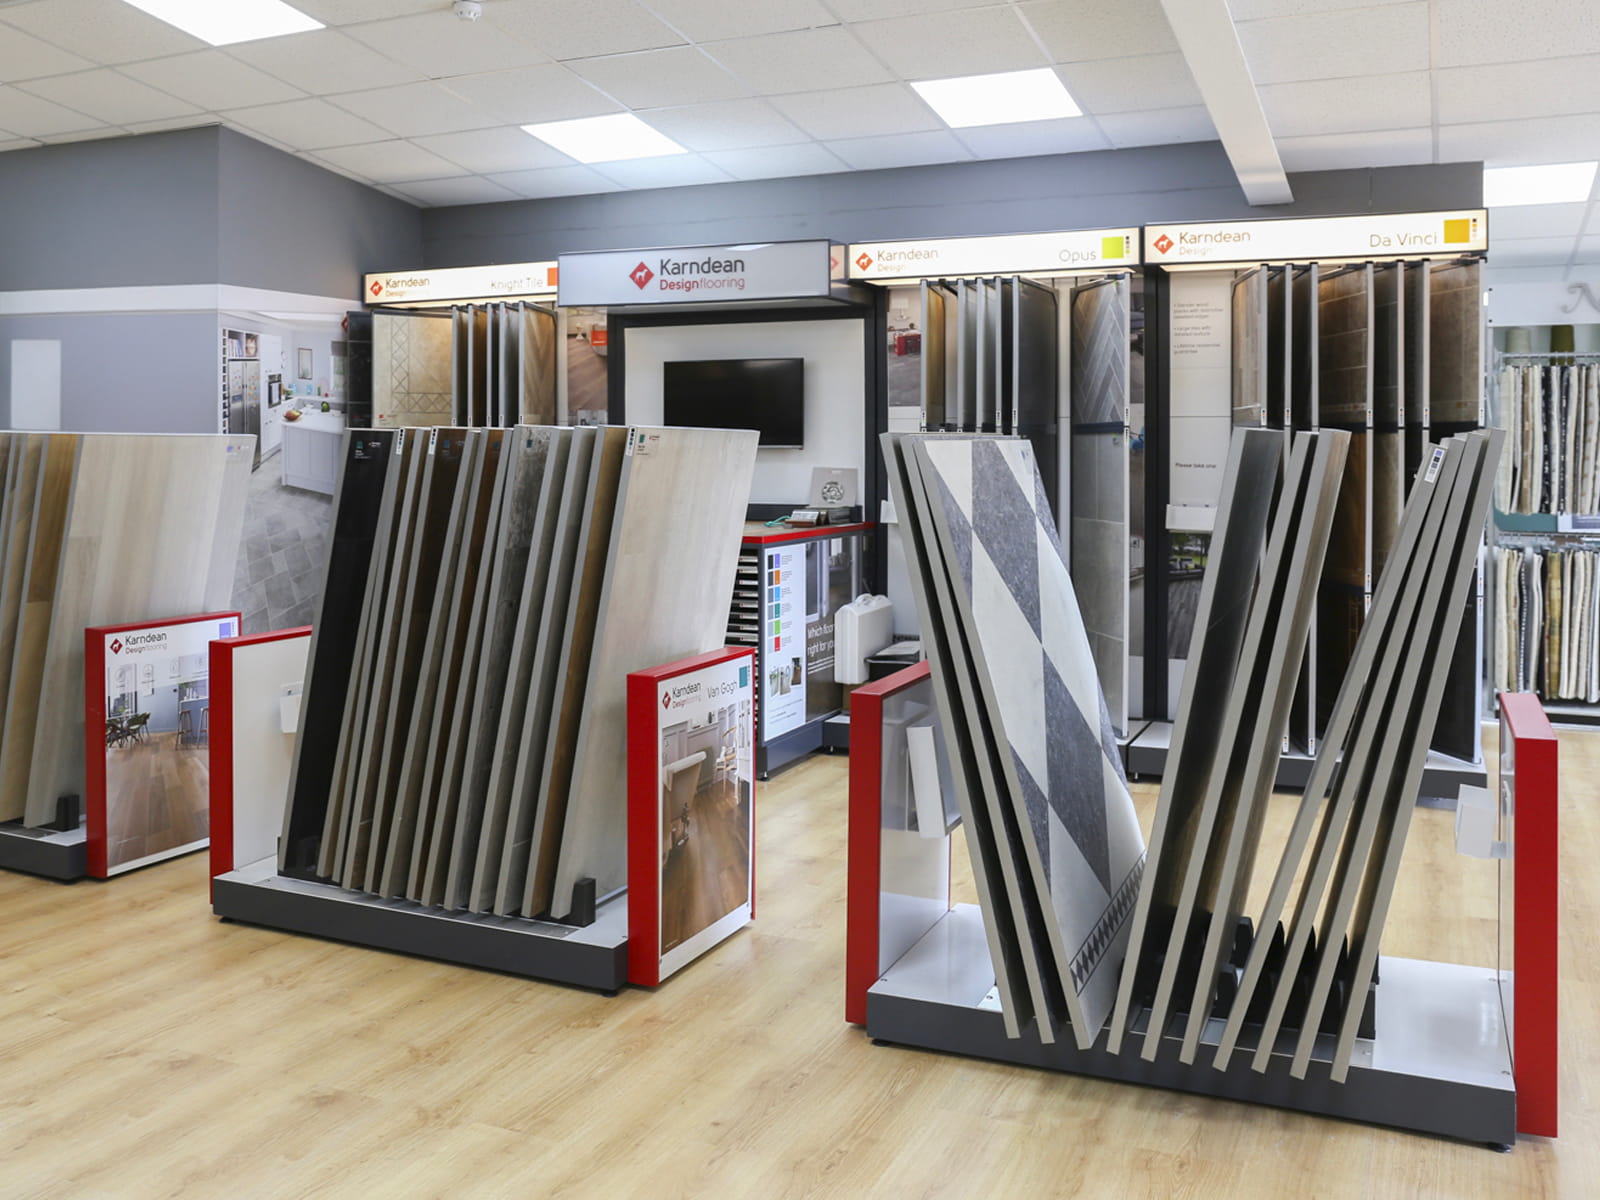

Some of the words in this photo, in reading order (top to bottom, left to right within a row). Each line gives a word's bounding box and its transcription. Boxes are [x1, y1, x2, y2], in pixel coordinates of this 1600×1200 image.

[1179, 231, 1251, 246] Karndean
[1369, 234, 1391, 248] Da
[1396, 233, 1438, 246] Vinci
[877, 249, 939, 263] Karndean
[1058, 249, 1097, 264] Opus
[658, 256, 746, 276] Karndean
[385, 277, 431, 290] Karndean
[490, 279, 523, 292] Knight
[526, 276, 544, 289] Tile
[659, 277, 746, 293] Designflooring
[124, 632, 167, 646] Karndean
[807, 625, 823, 640] Which
[807, 641, 819, 657] right
[671, 682, 702, 699] Karndean
[707, 685, 720, 699] Van
[720, 680, 738, 696] Gogh
